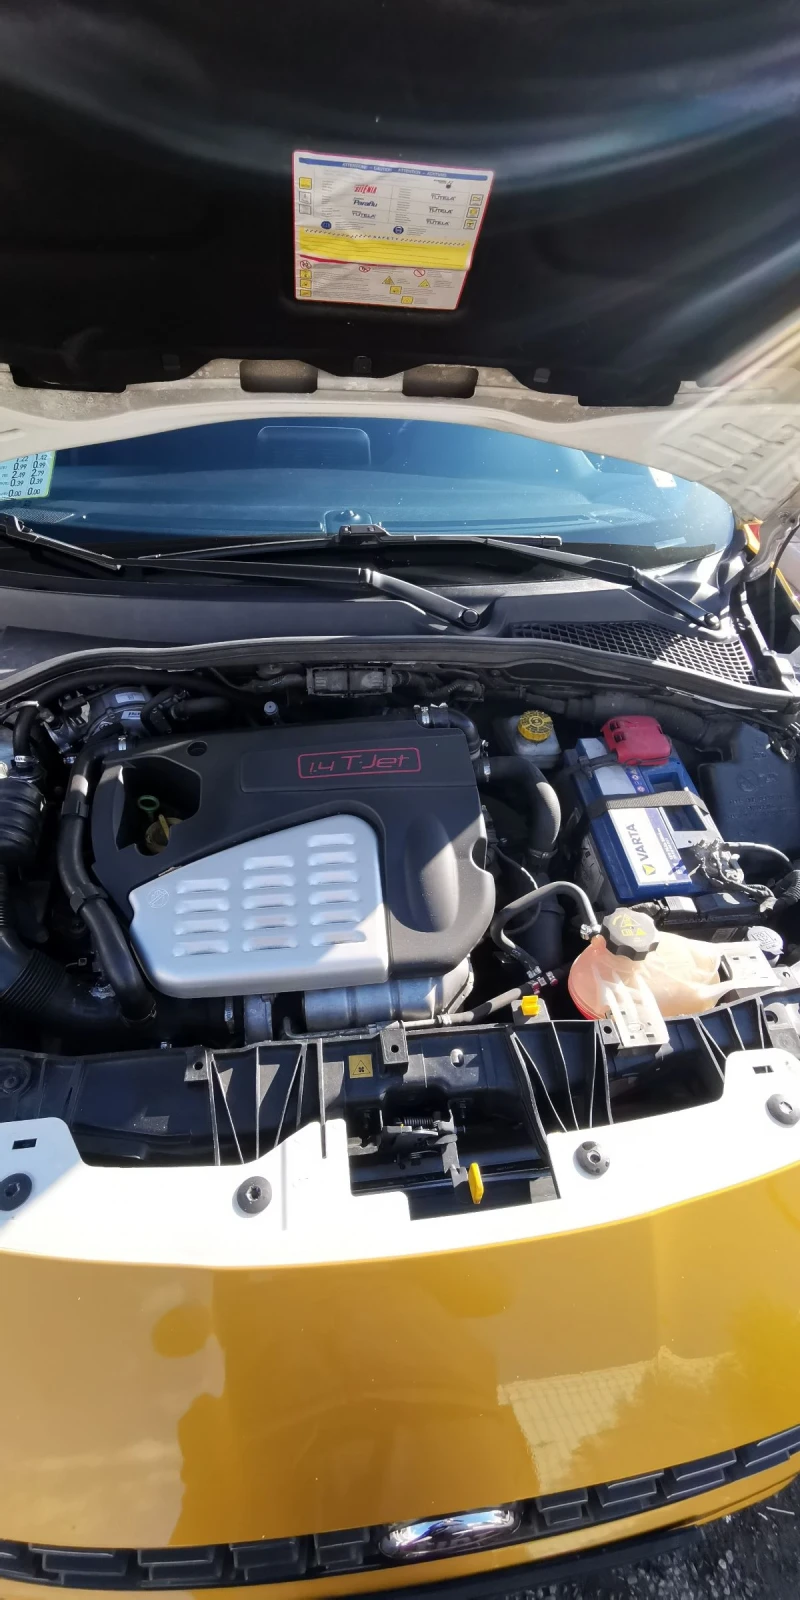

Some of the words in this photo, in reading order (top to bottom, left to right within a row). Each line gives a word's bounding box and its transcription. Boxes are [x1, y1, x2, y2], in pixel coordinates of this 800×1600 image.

[353, 199, 378, 207] Paraflu
[14, 462, 27, 470] 0.99
[309, 760, 336, 774] 1.4
[628, 823, 649, 862] VARTA
